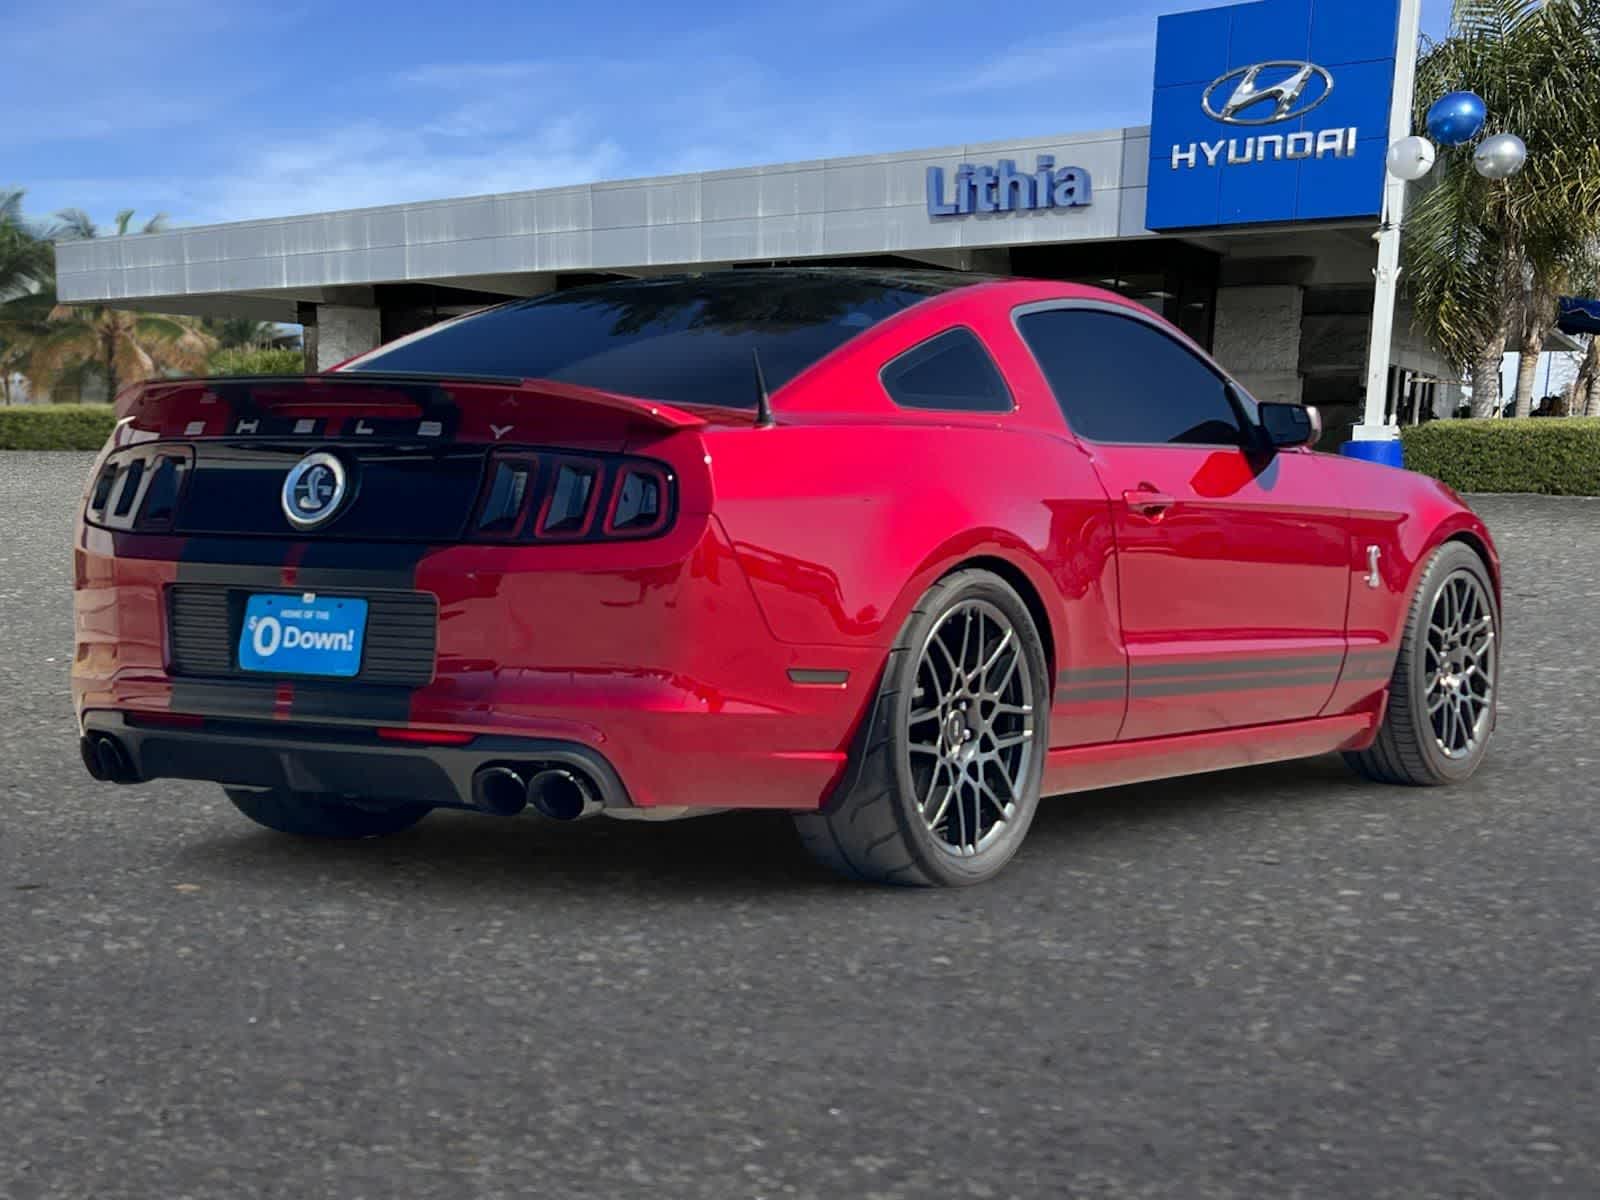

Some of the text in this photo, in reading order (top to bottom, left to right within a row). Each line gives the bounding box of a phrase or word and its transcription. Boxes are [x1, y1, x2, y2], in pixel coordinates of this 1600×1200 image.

[1171, 127, 1358, 169] HYUNDAI
[926, 154, 1093, 217] Lithia
[184, 418, 514, 439] SHELBY
[283, 625, 355, 652] Down!
